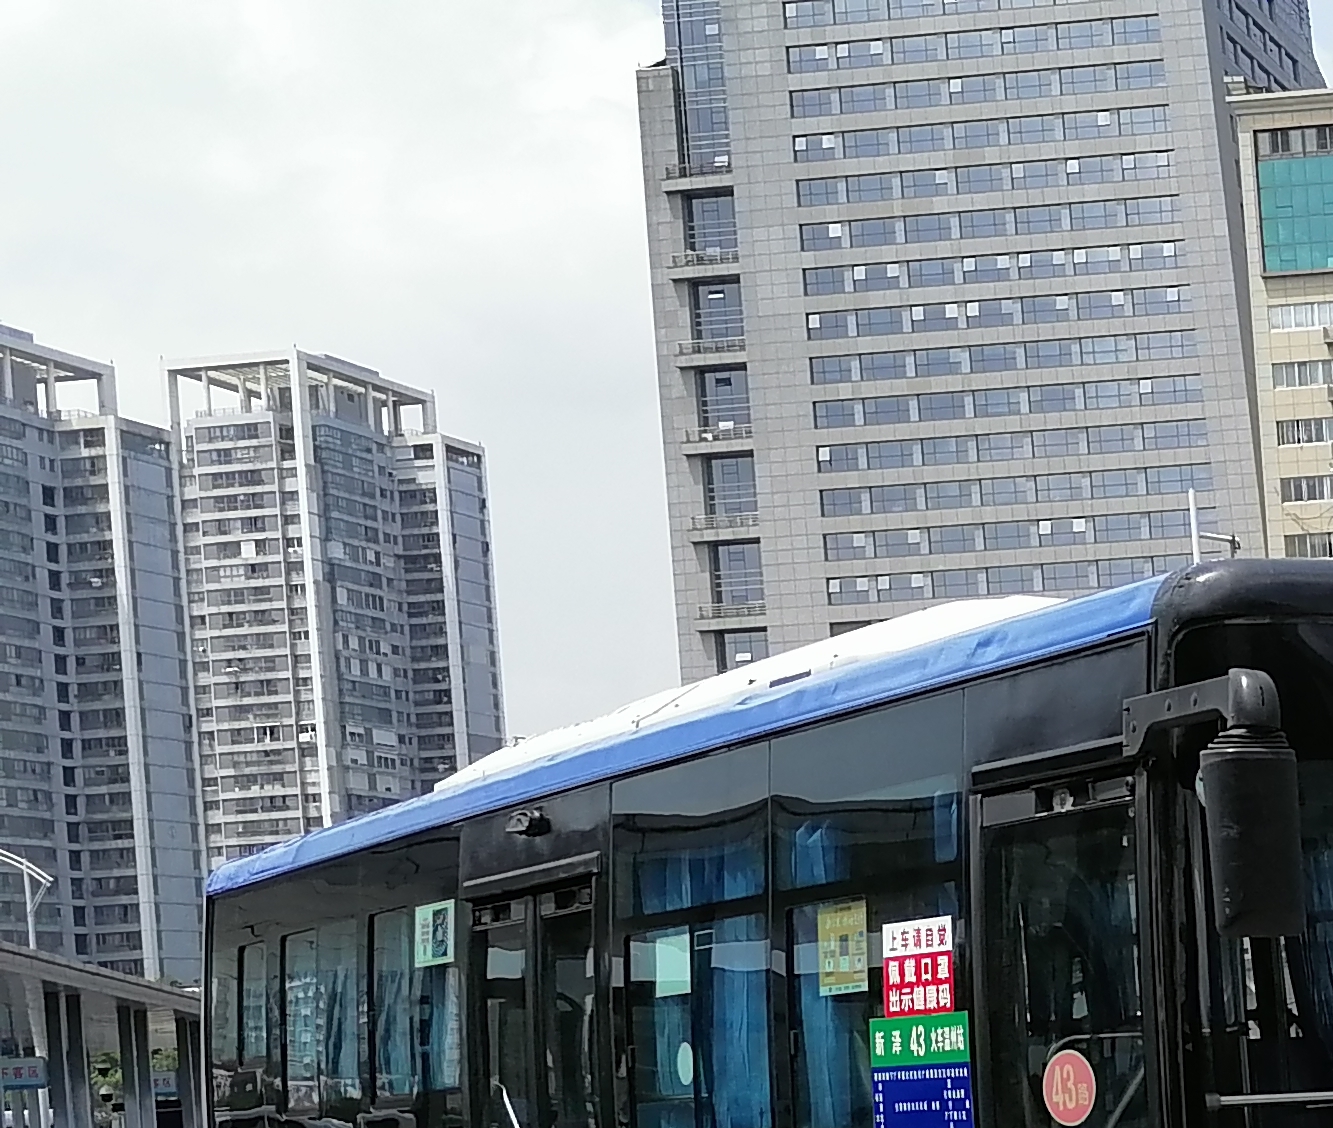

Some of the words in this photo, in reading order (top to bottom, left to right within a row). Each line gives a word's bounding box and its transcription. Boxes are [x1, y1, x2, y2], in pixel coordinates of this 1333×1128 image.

[889, 923, 947, 952] 上车请自觉
[888, 955, 949, 985] 佩戴口罩
[888, 983, 951, 1012] 出示健康码
[909, 1024, 926, 1057] 43
